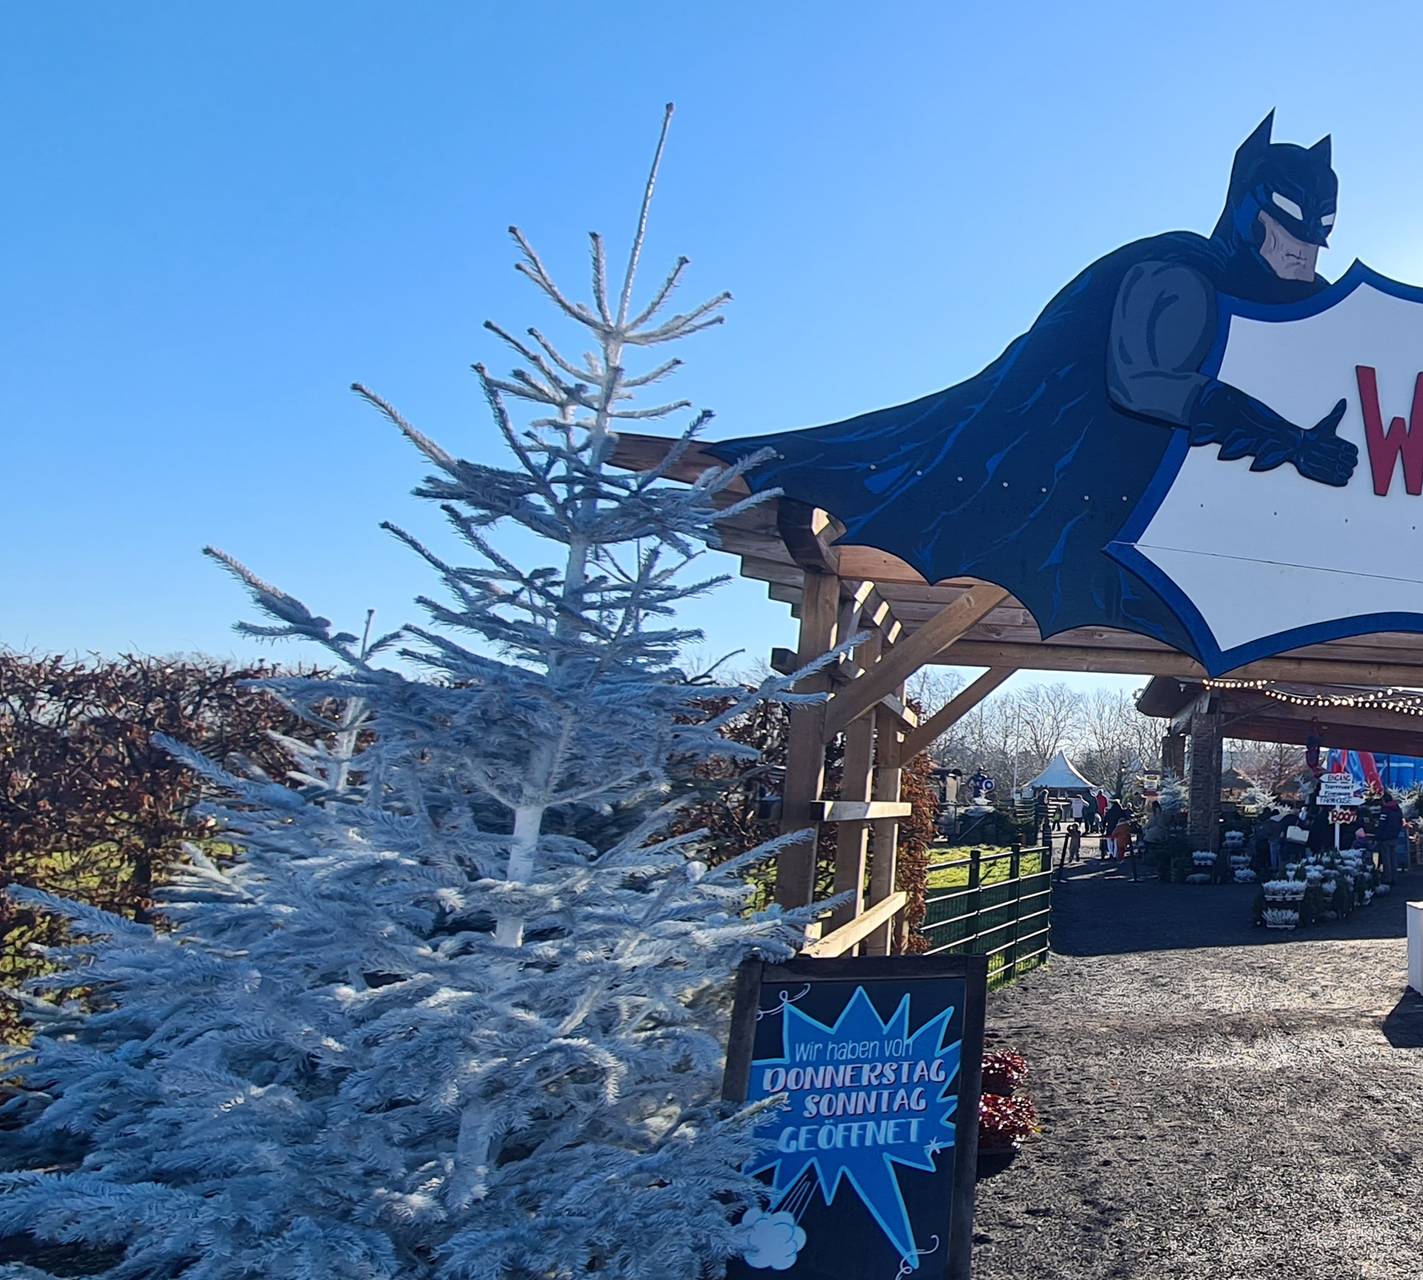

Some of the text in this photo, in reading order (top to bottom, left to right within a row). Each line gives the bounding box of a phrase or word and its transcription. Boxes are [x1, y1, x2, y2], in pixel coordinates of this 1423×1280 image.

[795, 1038, 913, 1062] Wir haben von
[762, 1058, 946, 1093] DONNERSTAG
[802, 1087, 927, 1118] SONNTAG
[778, 1118, 925, 1153] GEÖFFNET
